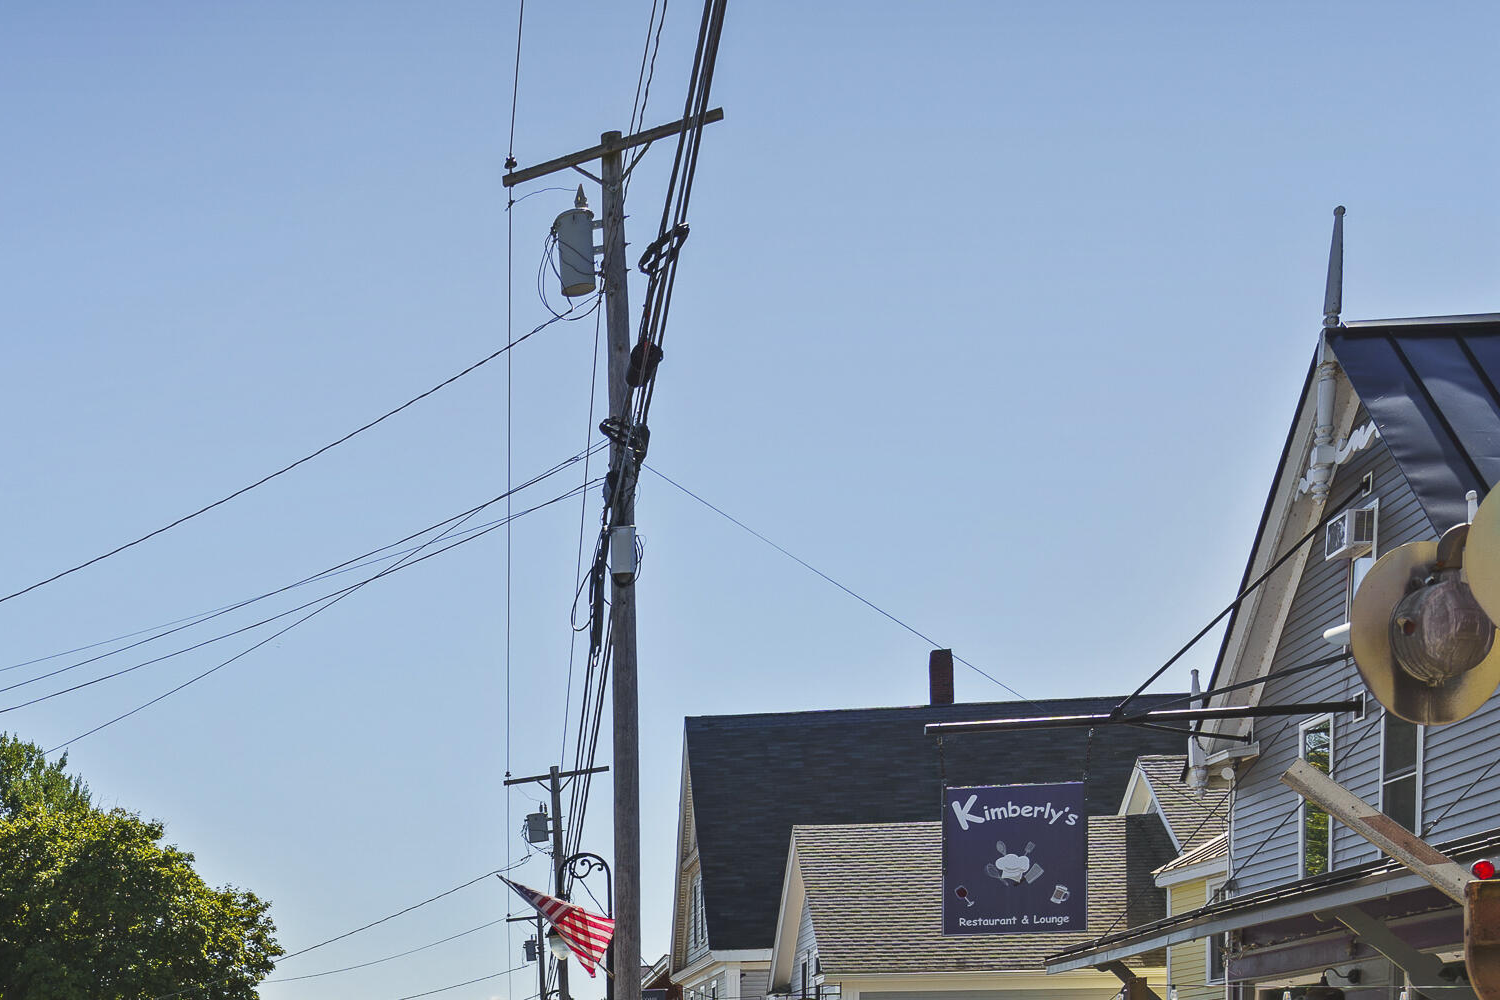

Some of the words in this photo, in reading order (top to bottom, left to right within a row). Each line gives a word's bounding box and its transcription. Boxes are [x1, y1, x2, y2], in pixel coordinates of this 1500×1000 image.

[952, 795, 1078, 831] Kimberly's
[959, 916, 1017, 927] Restaurant
[1021, 915, 1029, 925] &
[1033, 914, 1070, 926] Lounge
